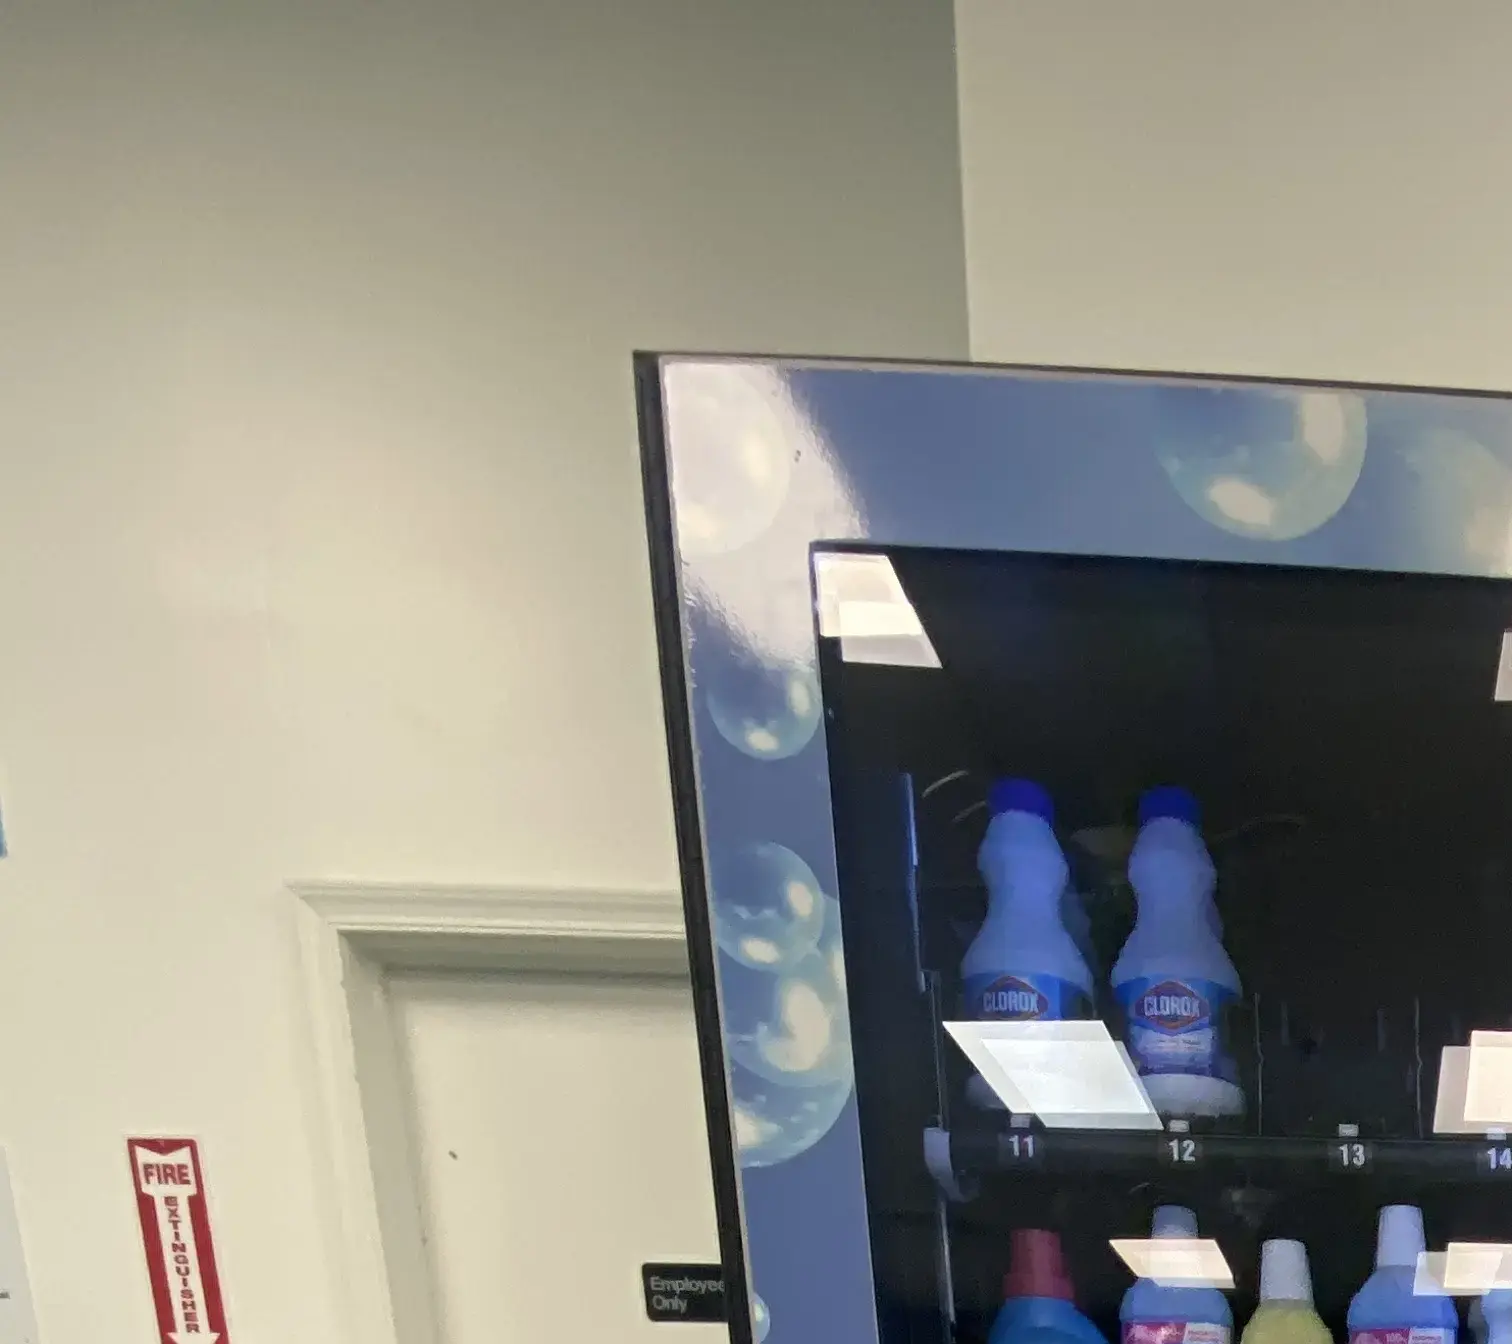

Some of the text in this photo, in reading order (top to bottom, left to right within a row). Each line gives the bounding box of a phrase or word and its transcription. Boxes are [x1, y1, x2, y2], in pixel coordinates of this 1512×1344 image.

[982, 990, 1040, 1013] CLOROX
[1143, 995, 1200, 1017] CLOROX
[1009, 1135, 1512, 1170] 11 12 13 14
[142, 1163, 191, 1185] FIRE
[164, 1196, 201, 1333] EXTINGUISHER
[652, 1294, 688, 1314] Only
